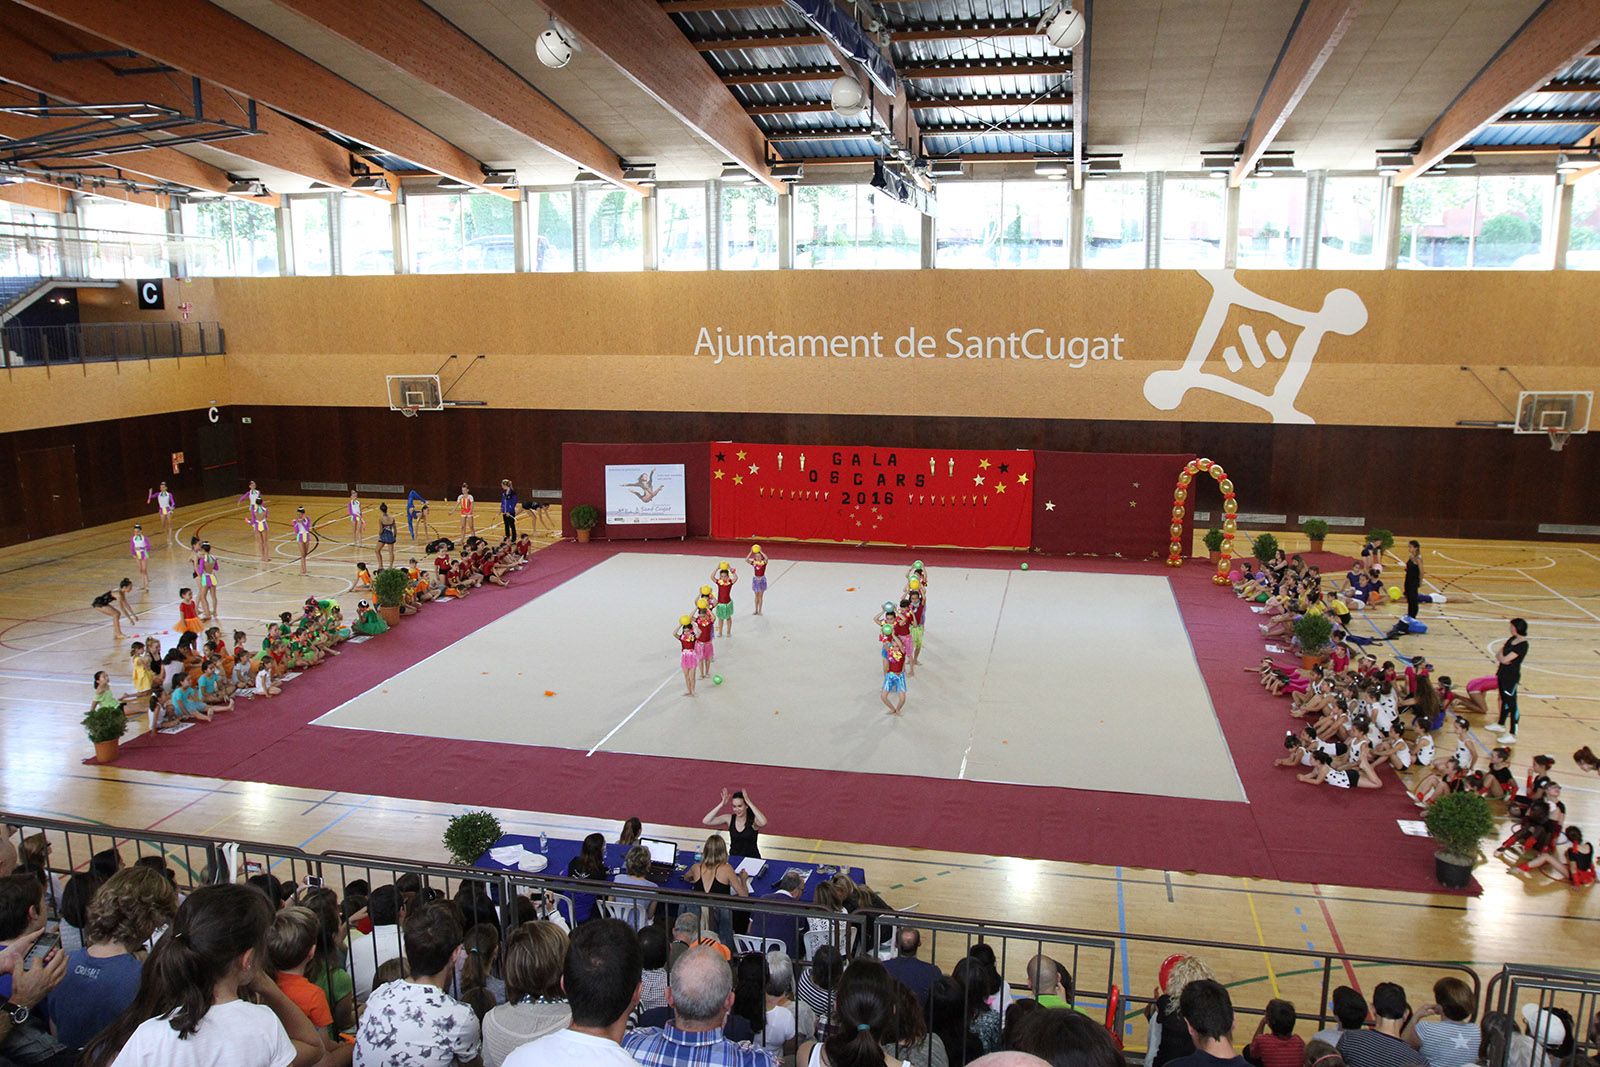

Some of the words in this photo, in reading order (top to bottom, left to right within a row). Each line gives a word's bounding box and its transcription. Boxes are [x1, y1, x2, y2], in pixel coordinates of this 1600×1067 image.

[142, 282, 158, 304] C
[693, 326, 884, 365] Ajuntament
[894, 326, 937, 359] de
[945, 327, 1125, 369] SantCugat
[208, 406, 219, 423] C
[832, 451, 897, 467] GALA
[809, 469, 925, 488] OSCARS
[841, 491, 894, 505] 2016
